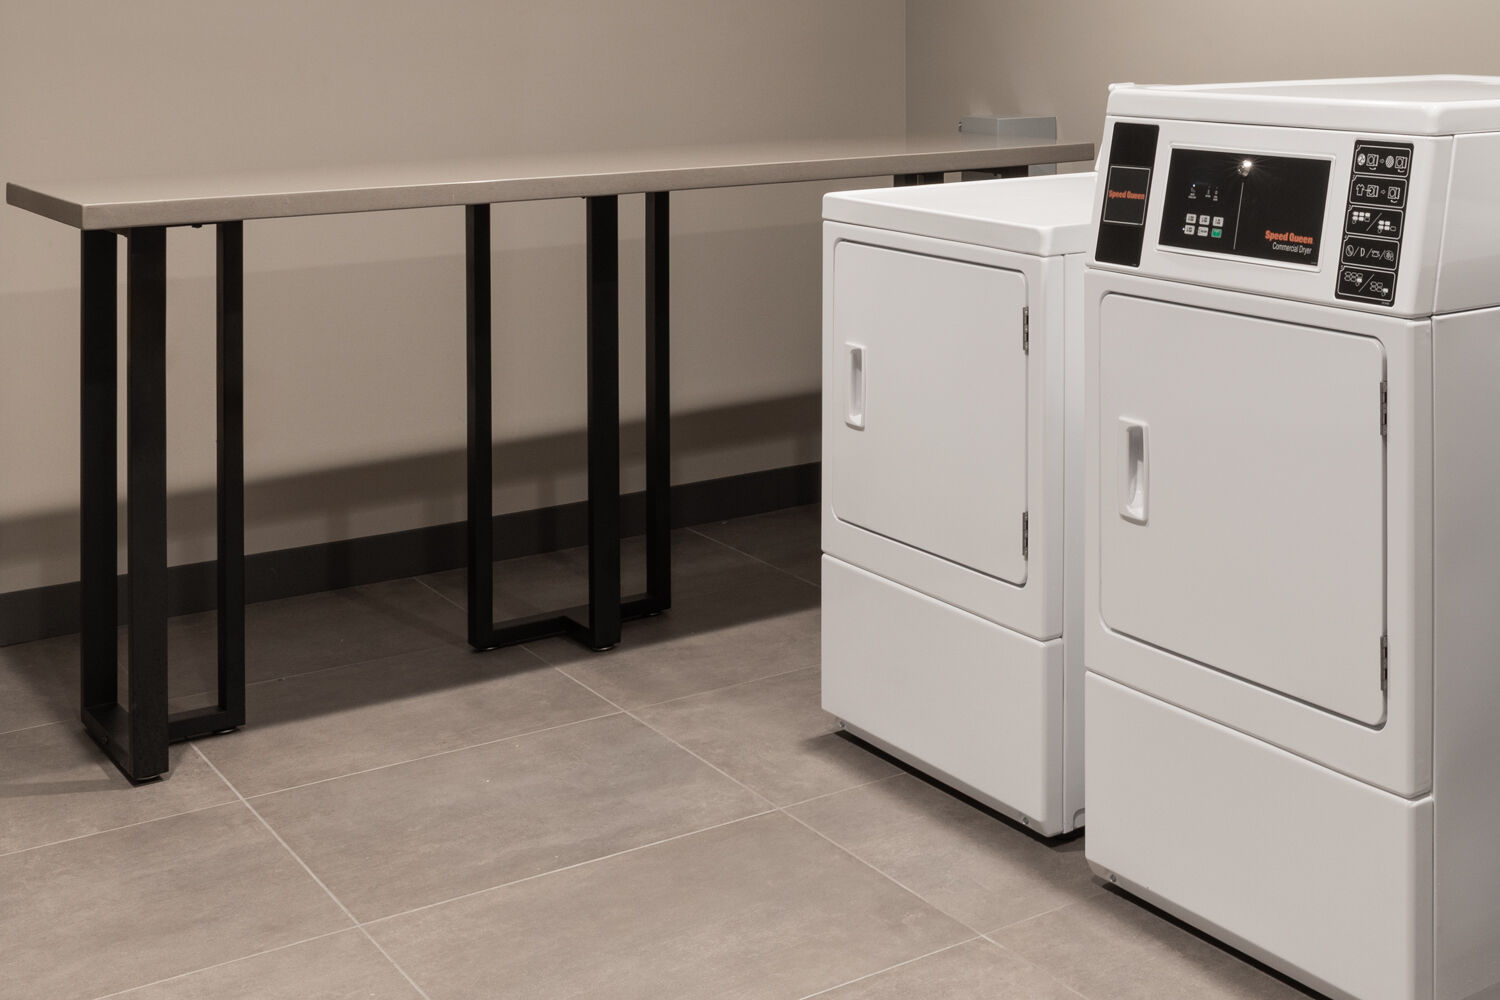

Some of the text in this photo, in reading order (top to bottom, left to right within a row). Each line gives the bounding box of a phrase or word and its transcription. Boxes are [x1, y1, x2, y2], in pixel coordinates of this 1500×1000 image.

[1109, 189, 1145, 200] Speed Queen
[1265, 230, 1313, 244] Speed Queen
[1272, 242, 1312, 255] Commercial Dryer
